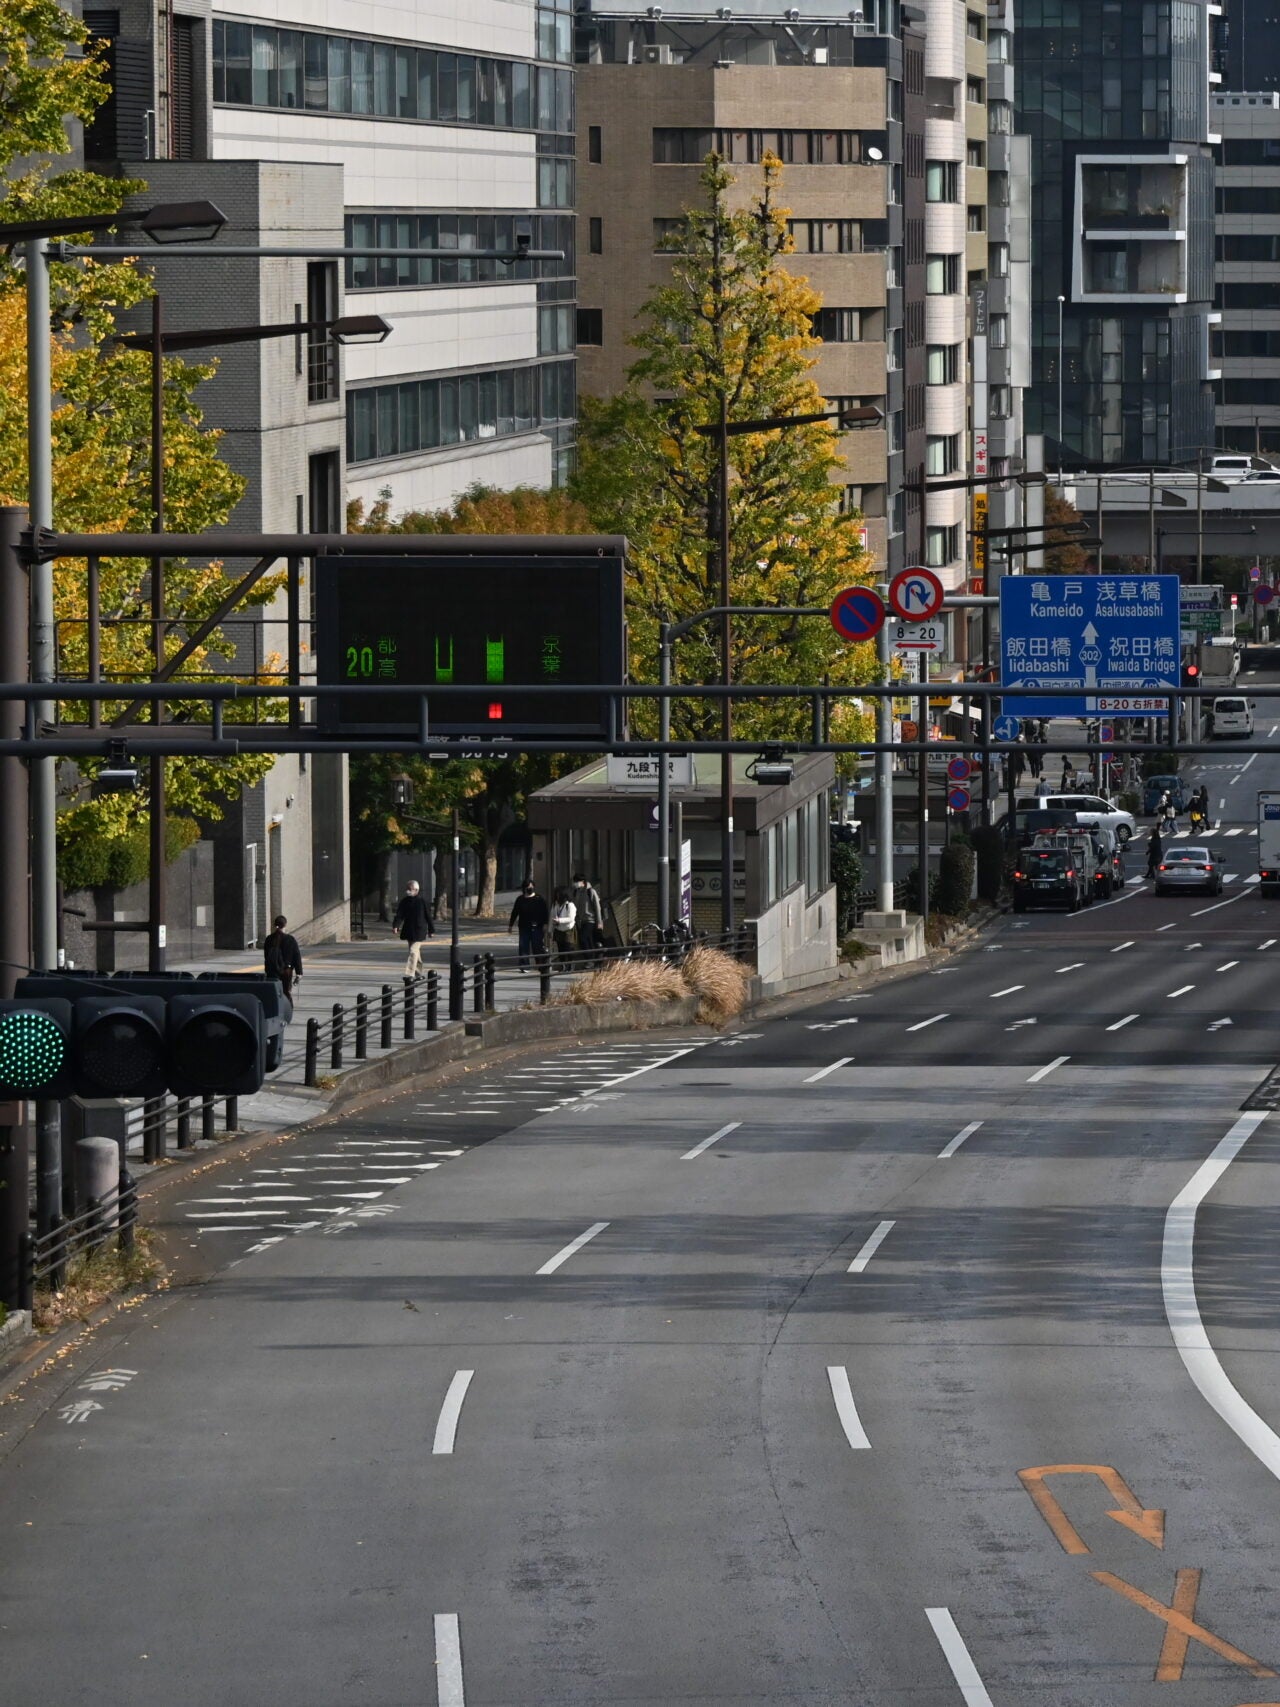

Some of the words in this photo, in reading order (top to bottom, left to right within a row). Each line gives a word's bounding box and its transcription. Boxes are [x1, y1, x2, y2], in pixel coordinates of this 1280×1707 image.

[975, 435, 987, 486] スギ薬
[1030, 582, 1083, 602] 亀戸
[1096, 581, 1162, 601] 浅草橋
[1030, 603, 1084, 617] Kameido
[1095, 603, 1164, 617] Asakusabashi
[897, 627, 936, 639] 8-20
[1006, 637, 1071, 657] 飯田橋
[1109, 637, 1174, 657] 祝田橋
[346, 646, 373, 677] 20
[1081, 651, 1099, 661] 302
[1009, 658, 1070, 673] Iidabashi
[1108, 658, 1140, 672] Iwaida
[1143, 658, 1176, 674] Bridge
[1100, 699, 1129, 709] 8-20
